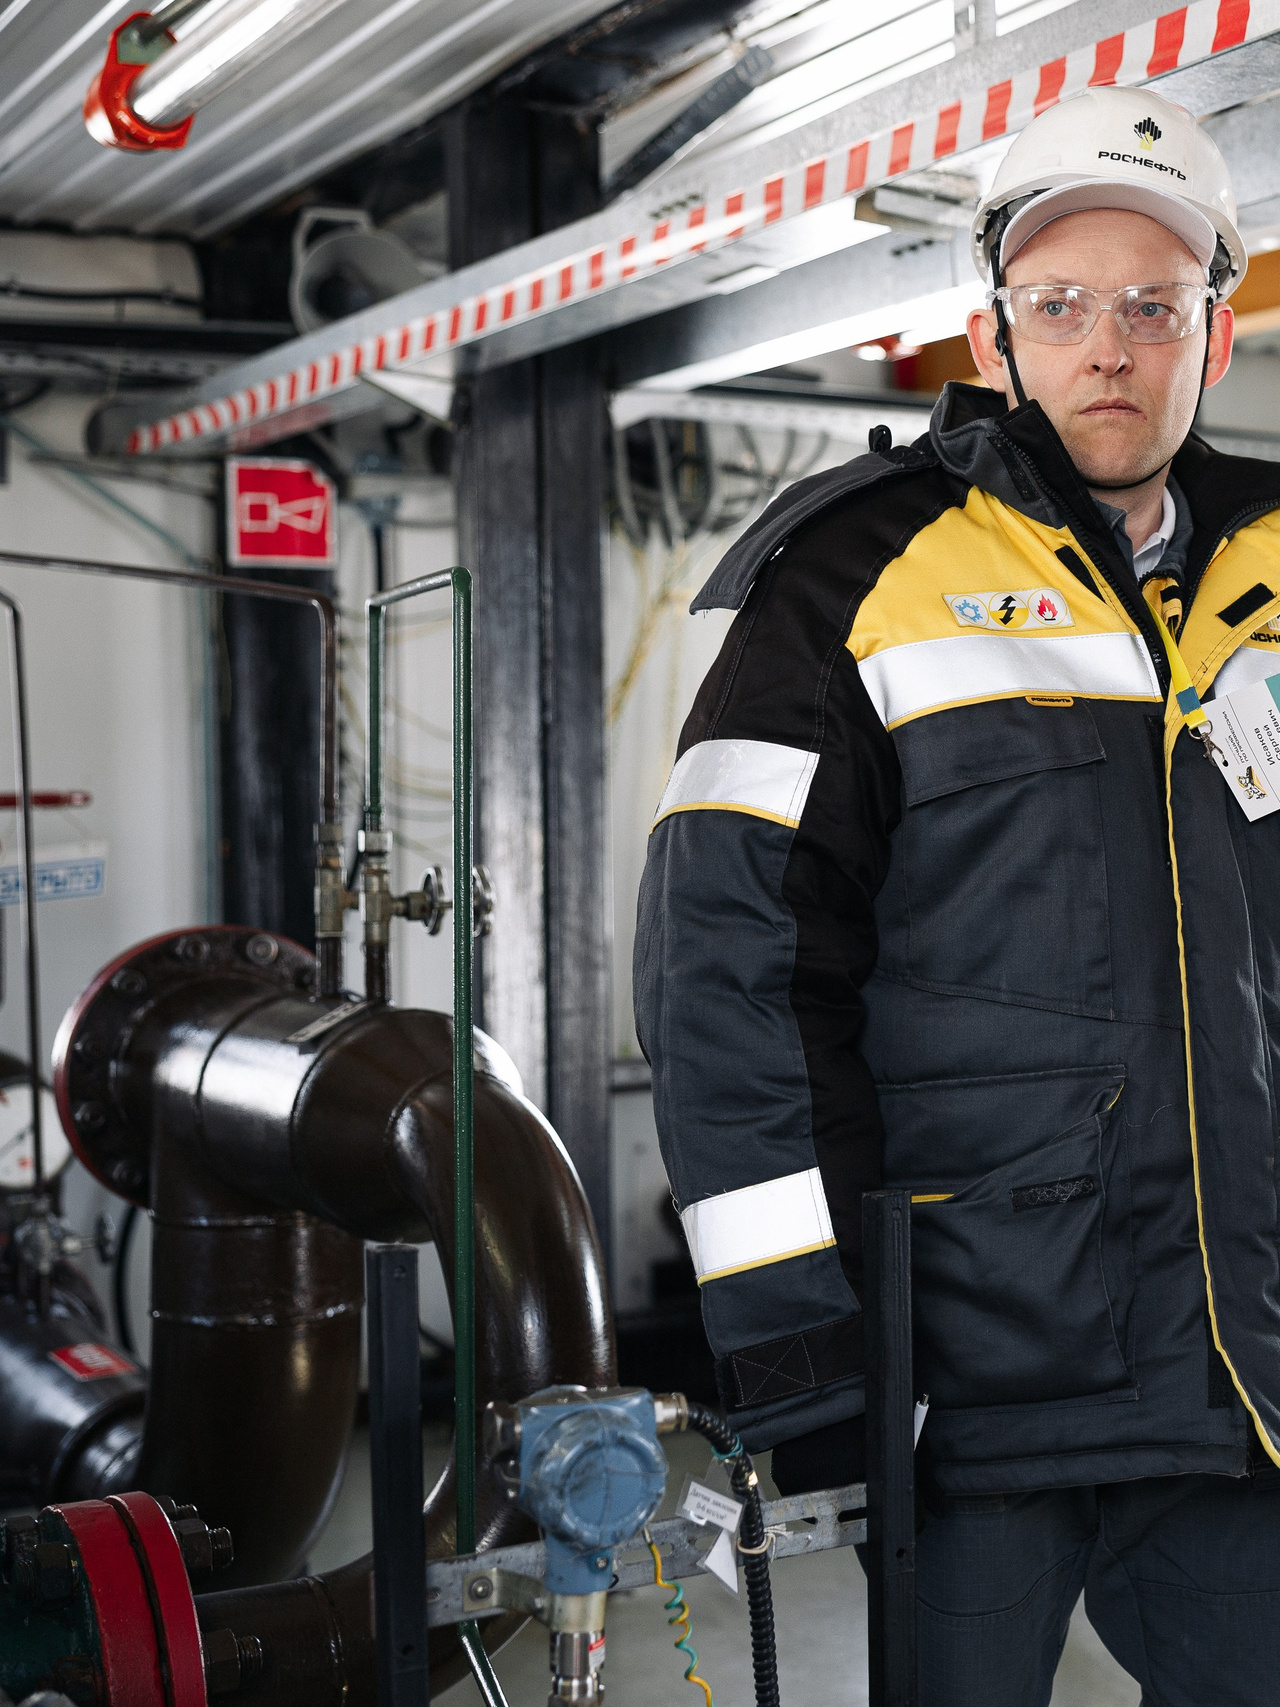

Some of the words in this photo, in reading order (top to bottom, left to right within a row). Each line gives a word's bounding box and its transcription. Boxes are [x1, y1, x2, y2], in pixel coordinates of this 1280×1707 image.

[1098, 151, 1187, 181] РОСНЕФТЬ
[1222, 710, 1243, 752] ПРОФЕССИИ
[1254, 727, 1275, 766] Исаков
